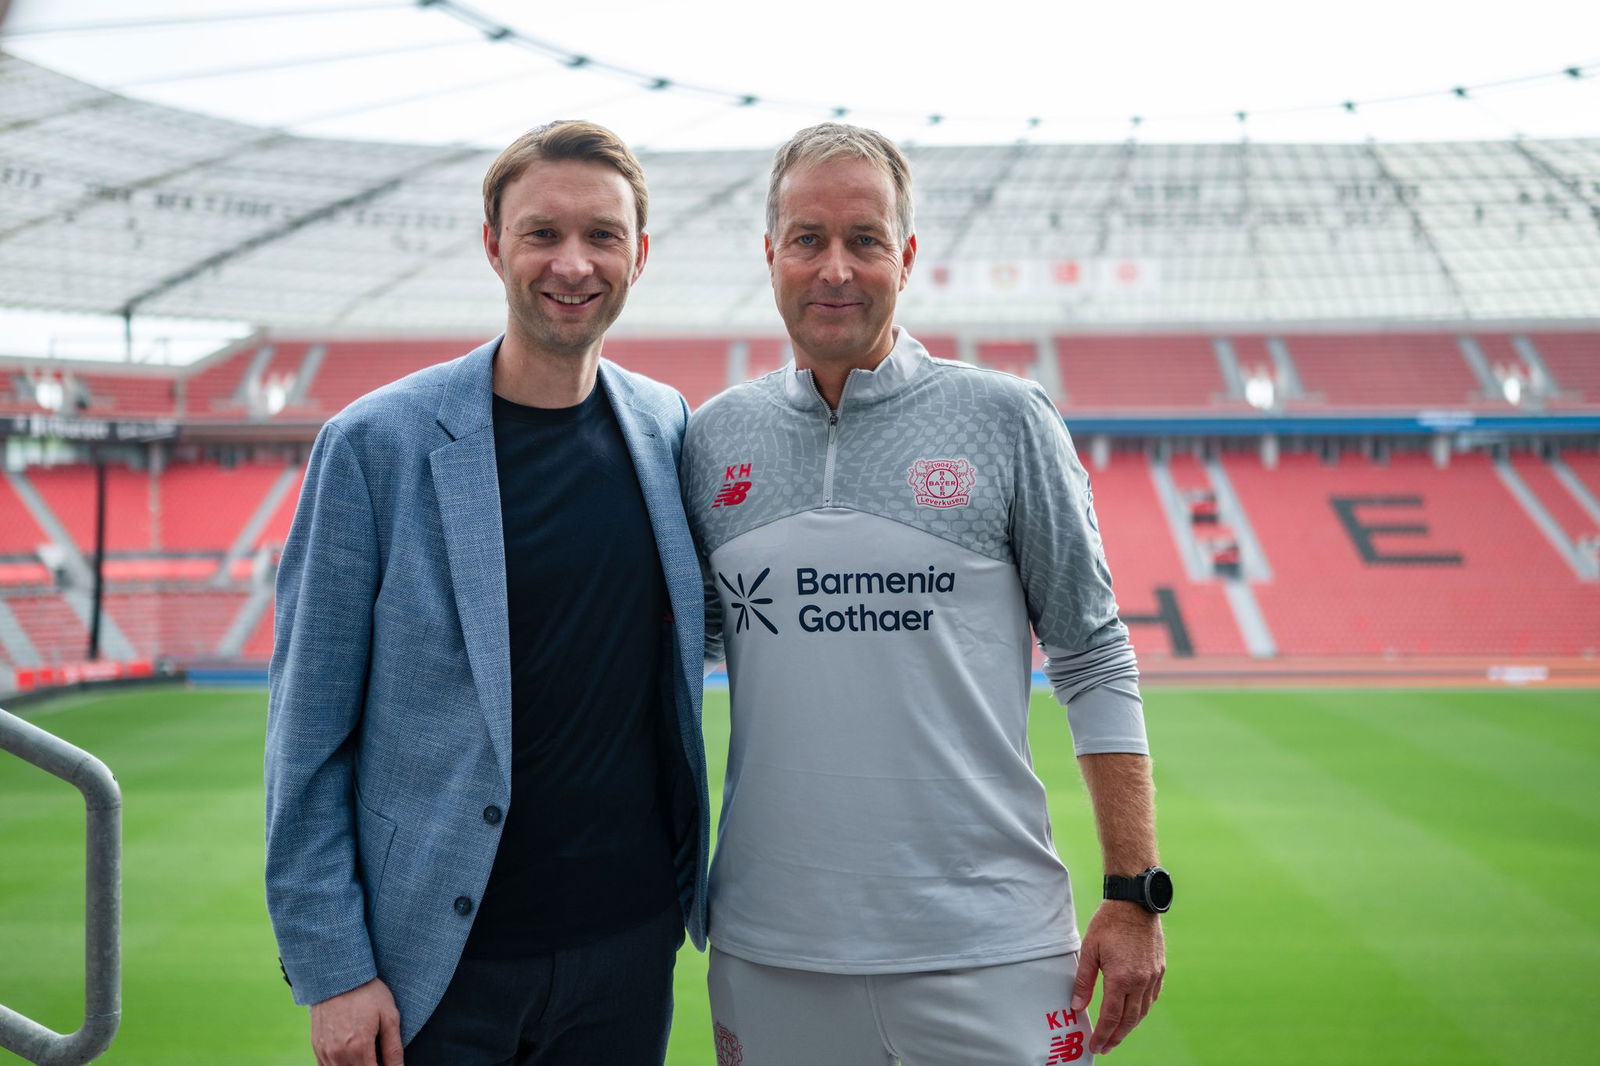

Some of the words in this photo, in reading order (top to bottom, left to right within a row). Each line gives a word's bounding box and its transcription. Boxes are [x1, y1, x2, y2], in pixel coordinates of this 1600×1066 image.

[920, 497, 965, 506] Leverkusen
[797, 565, 956, 595] Barmenia
[799, 604, 934, 633] Gothaer
